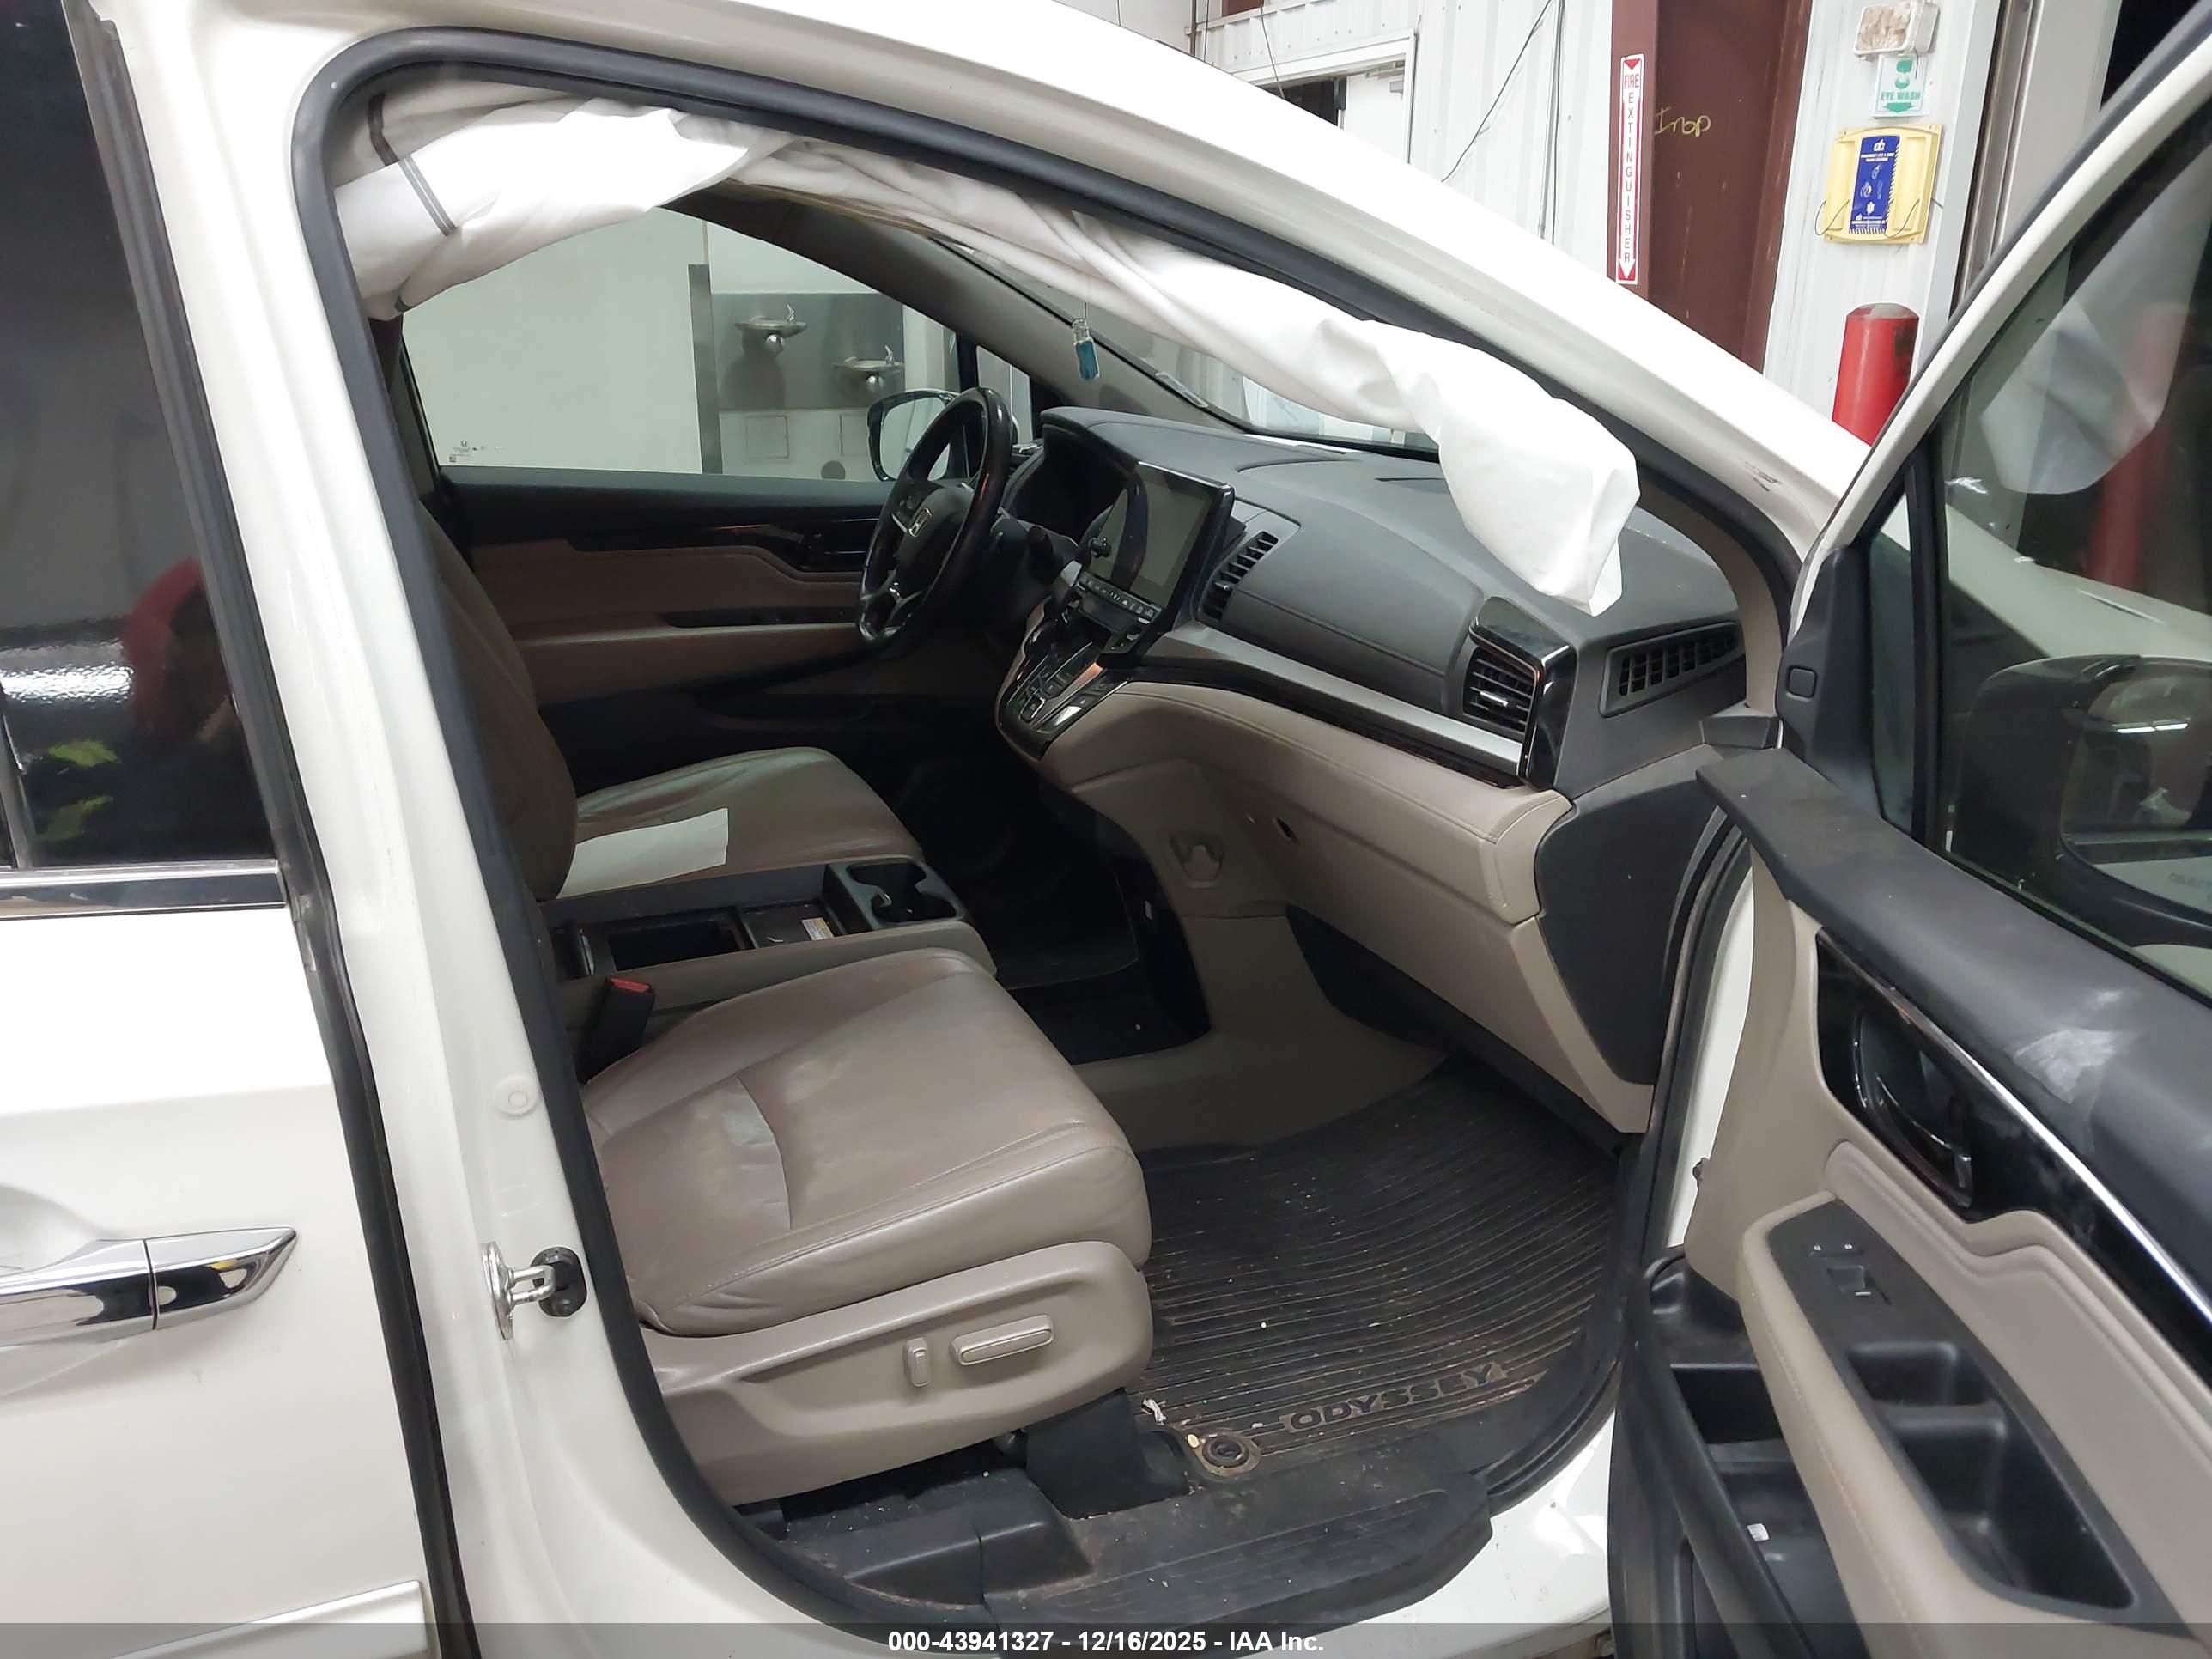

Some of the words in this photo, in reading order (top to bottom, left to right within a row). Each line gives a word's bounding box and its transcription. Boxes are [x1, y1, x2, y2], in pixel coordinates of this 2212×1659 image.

[1624, 73, 1639, 89] FIRE
[1881, 91, 1893, 100] EYE
[1897, 90, 1921, 100] WASH
[1624, 92, 1634, 263] EXTINGUISHER
[1291, 1364, 1494, 1430] ODYSSEY
